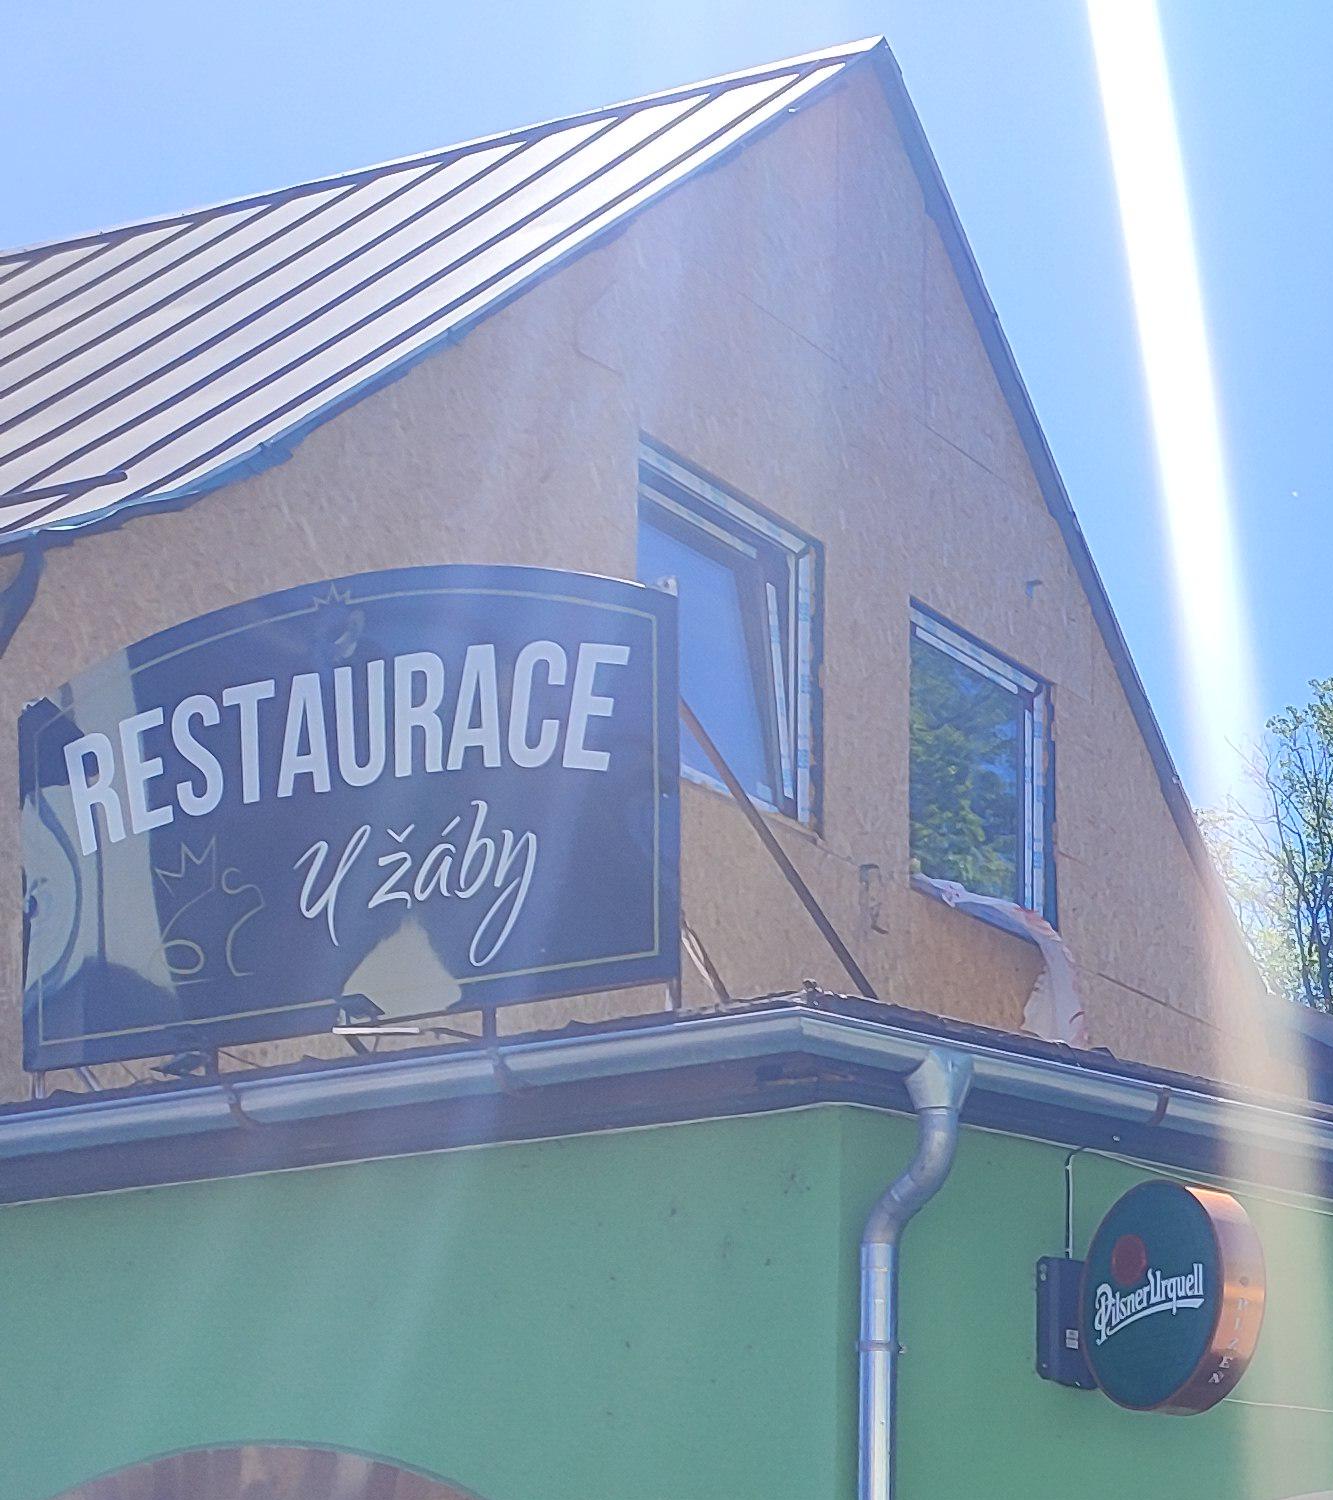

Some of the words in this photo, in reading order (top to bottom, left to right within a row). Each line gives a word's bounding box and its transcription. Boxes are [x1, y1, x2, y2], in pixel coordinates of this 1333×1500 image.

[63, 639, 631, 857] RESTAURACE
[293, 824, 371, 946] U
[368, 800, 537, 967] žáby
[1095, 1283, 1150, 1345] Pilsner
[1147, 1263, 1203, 1315] Urquell
